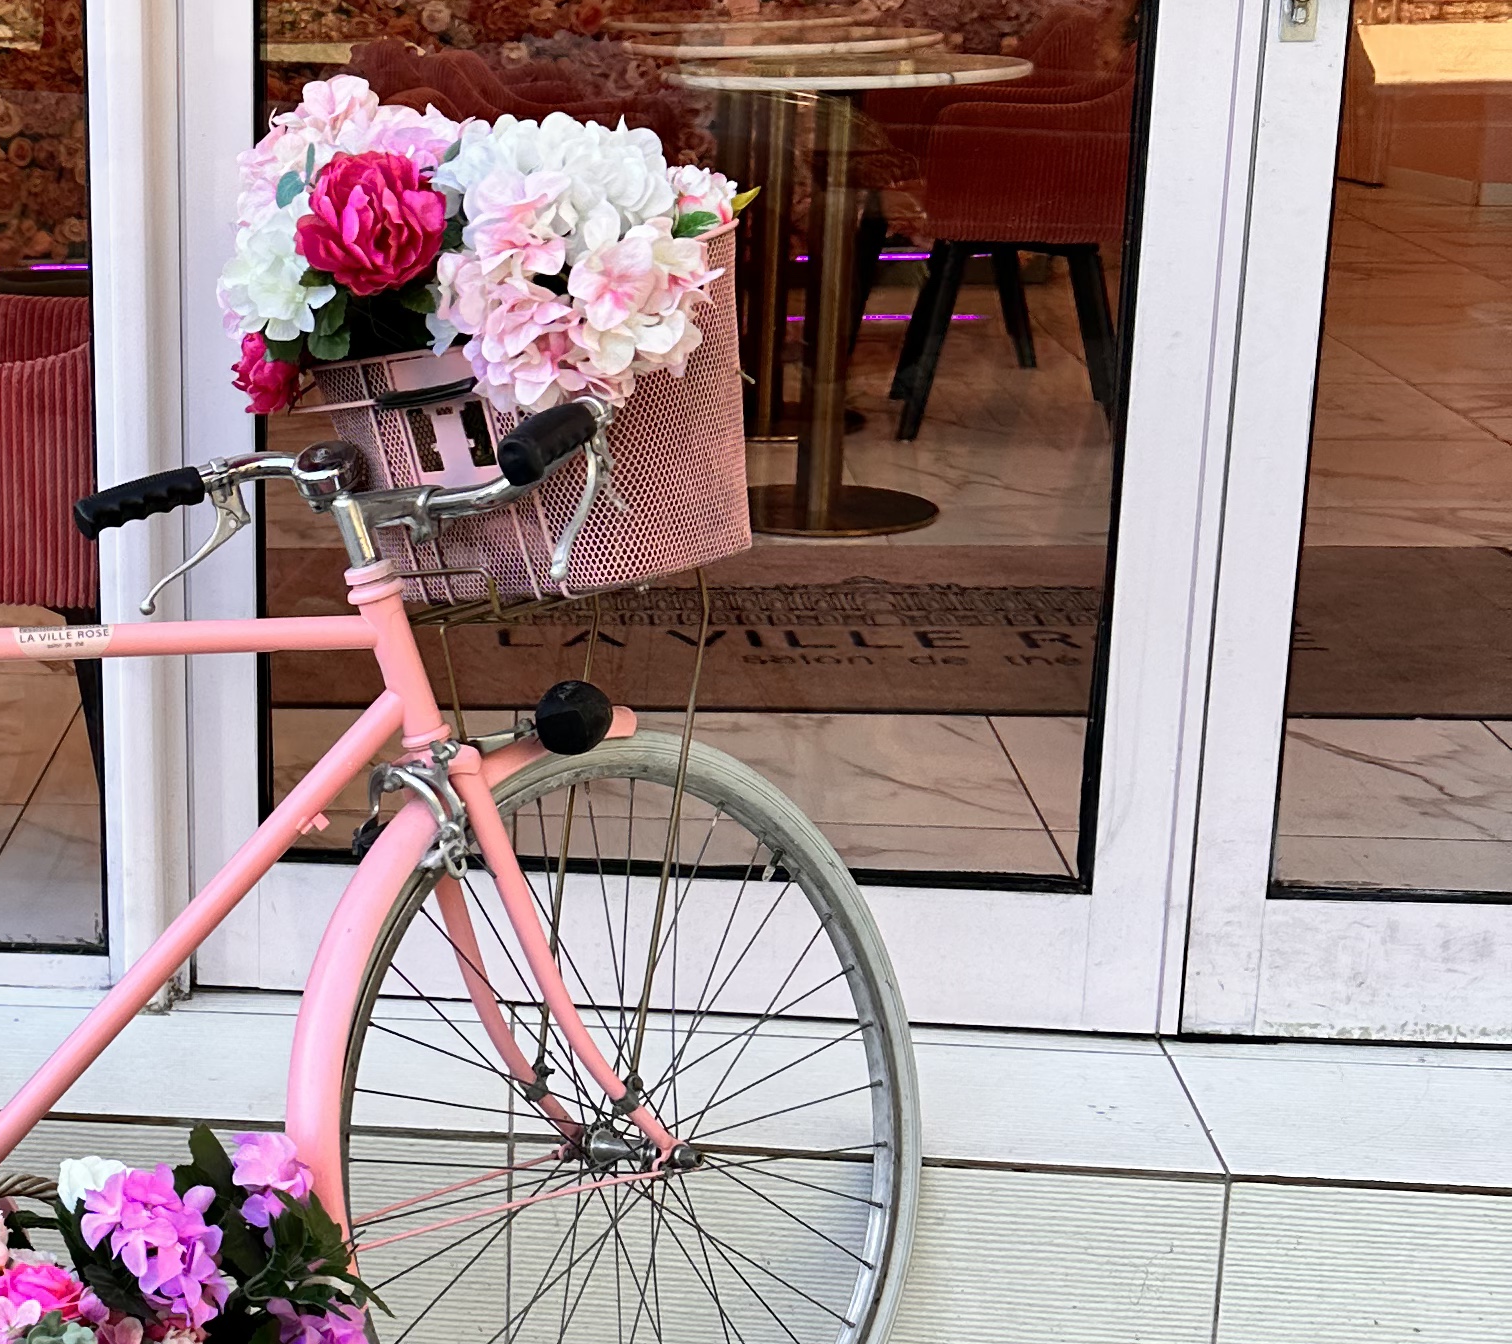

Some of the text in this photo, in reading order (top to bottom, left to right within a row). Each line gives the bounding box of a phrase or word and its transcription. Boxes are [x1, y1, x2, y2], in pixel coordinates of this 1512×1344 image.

[19, 629, 110, 644] LA VILLE ROSE
[498, 628, 625, 647] LA
[666, 629, 969, 649] VILLE
[908, 654, 969, 666] de
